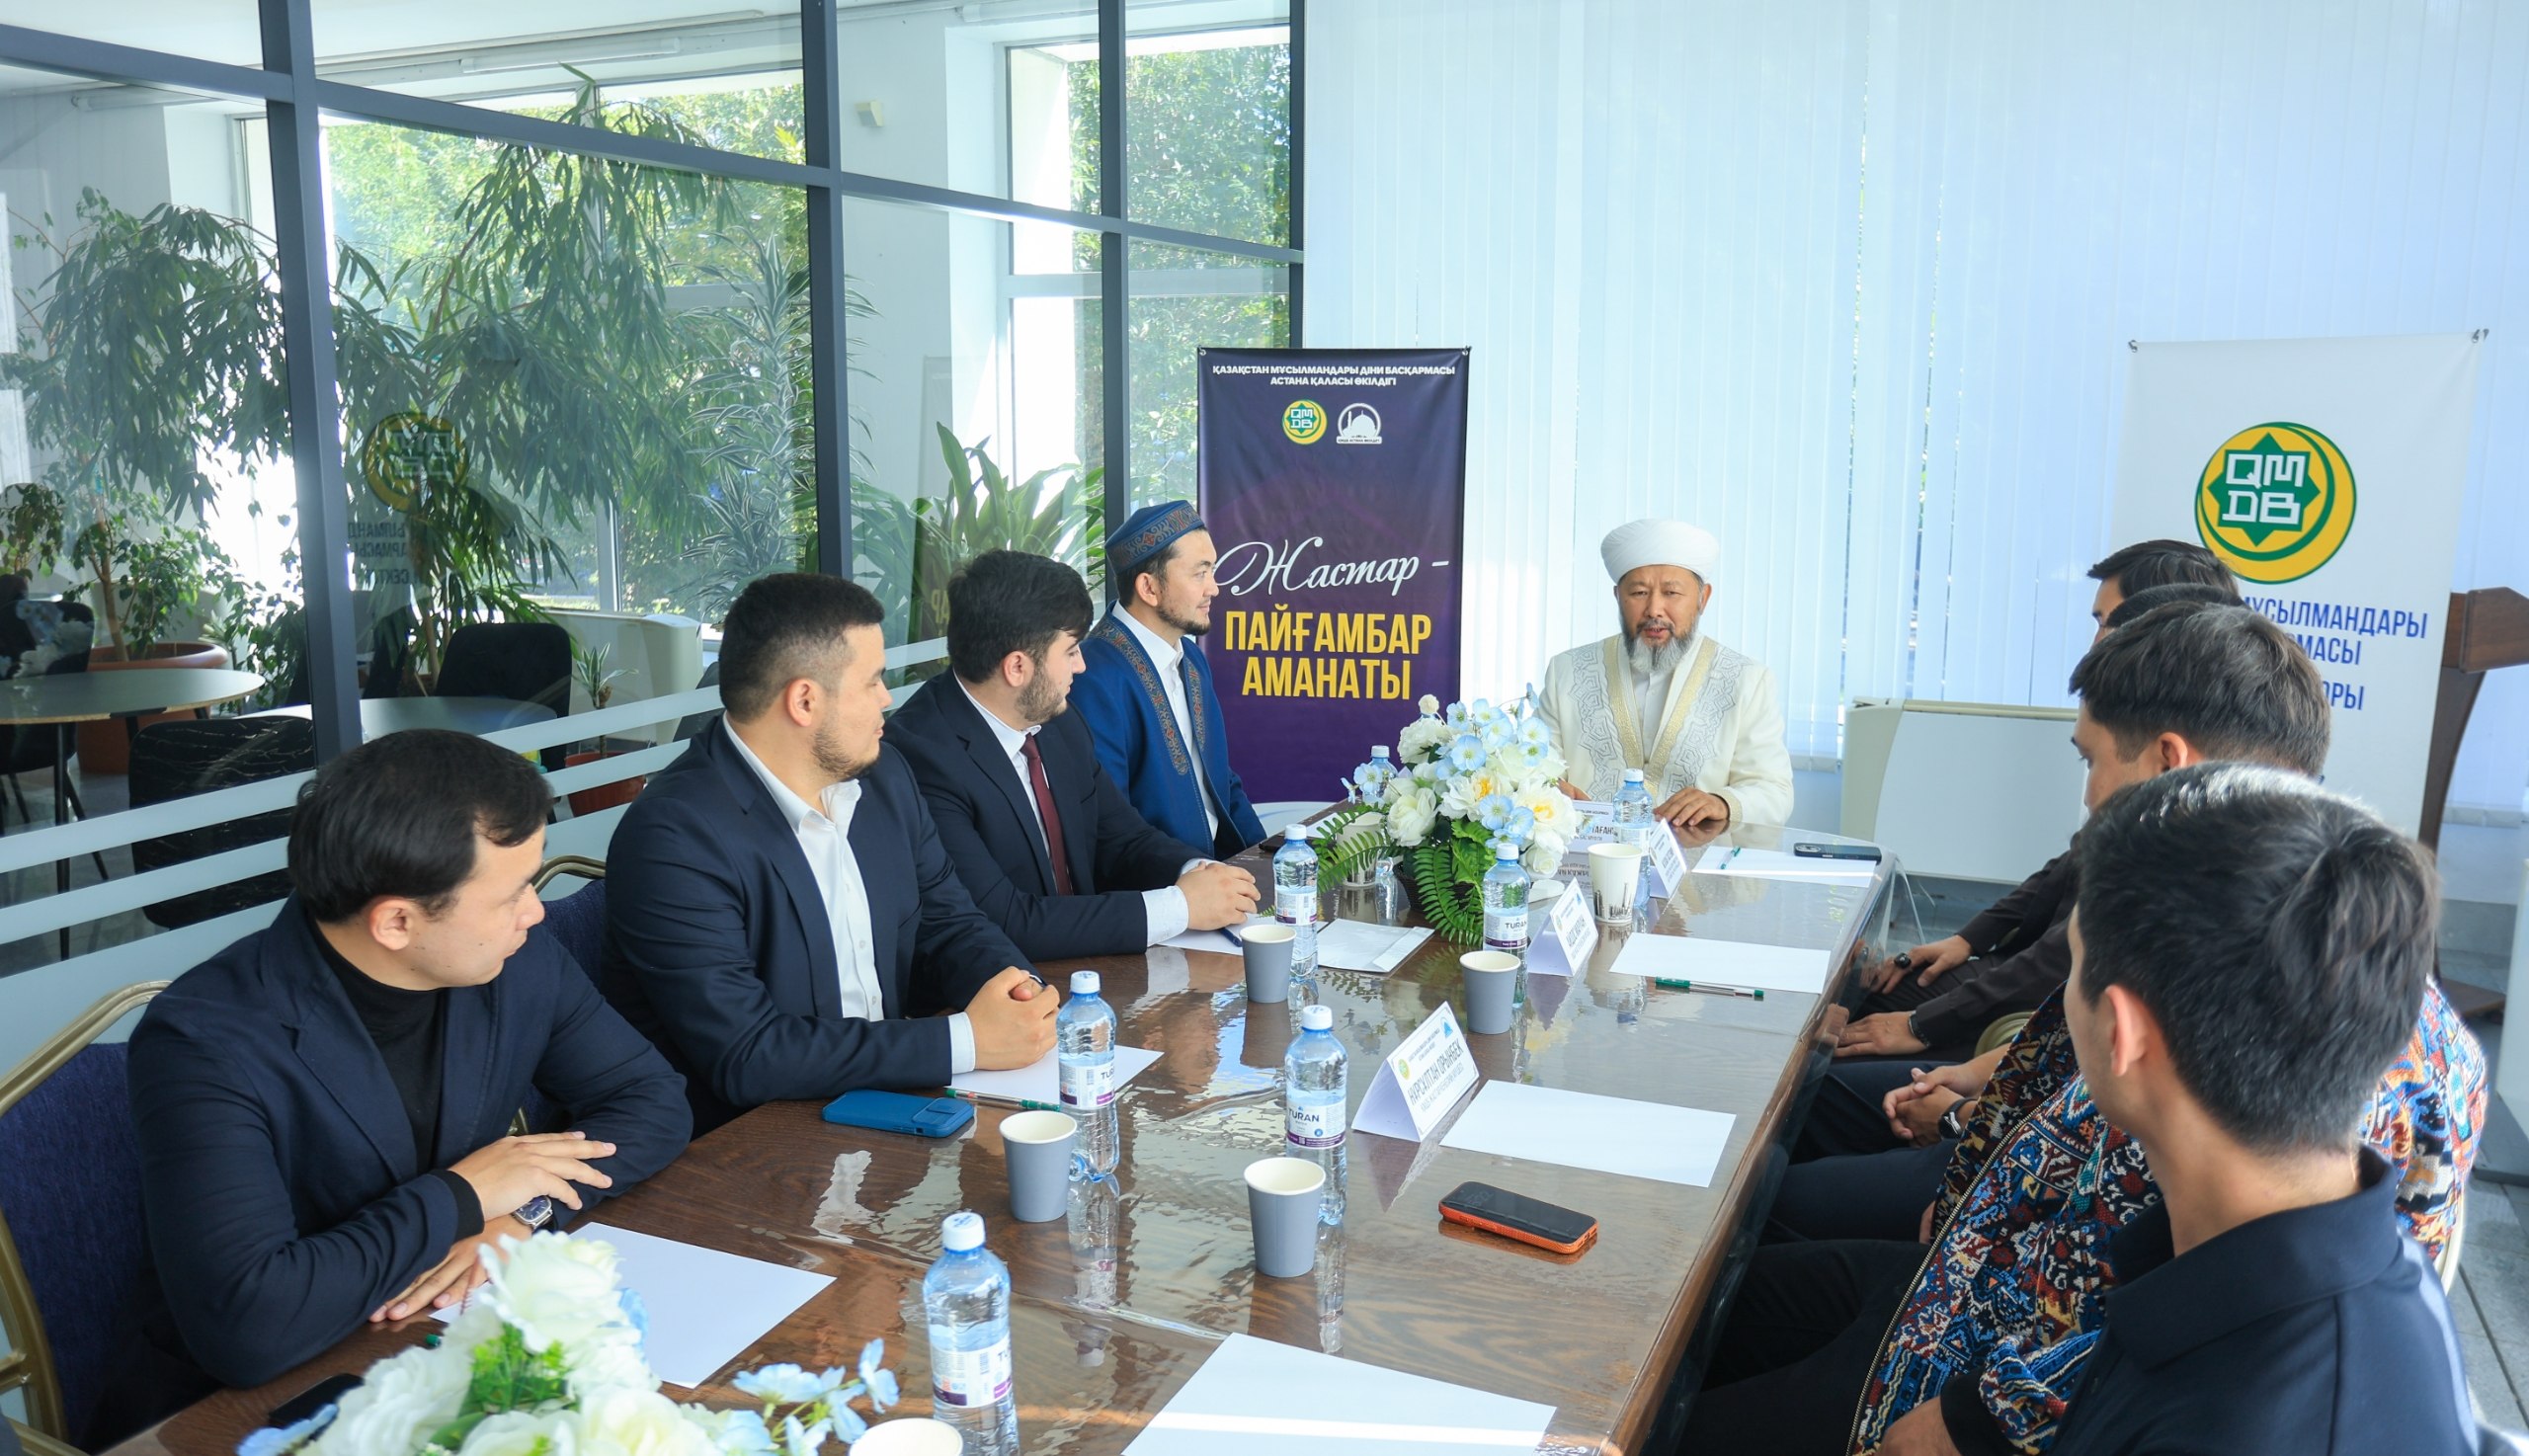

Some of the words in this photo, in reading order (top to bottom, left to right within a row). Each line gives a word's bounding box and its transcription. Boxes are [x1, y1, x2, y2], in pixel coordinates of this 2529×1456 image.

[1212, 365, 1269, 375] ҚАЗАҚСТАН
[1270, 365, 1358, 375] МҰСЫЛМАНДАРЫ
[1359, 365, 1384, 375] ДІНИ
[1385, 365, 1455, 376] БАСҚАРМАСЫ
[1270, 376, 1309, 385] АСТАНА
[1310, 376, 1353, 386] ҚАЛАСЫ
[1353, 377, 1397, 387] ӨКІЛДІГІ
[2226, 453, 2306, 489] QM
[2222, 490, 2301, 525] DB
[1213, 536, 1420, 597] Жастар
[1225, 603, 1431, 655] ПАЙҒАМБАР
[1242, 656, 1411, 700] АМАНАТЫ
[1288, 1107, 1320, 1123] TURAN
